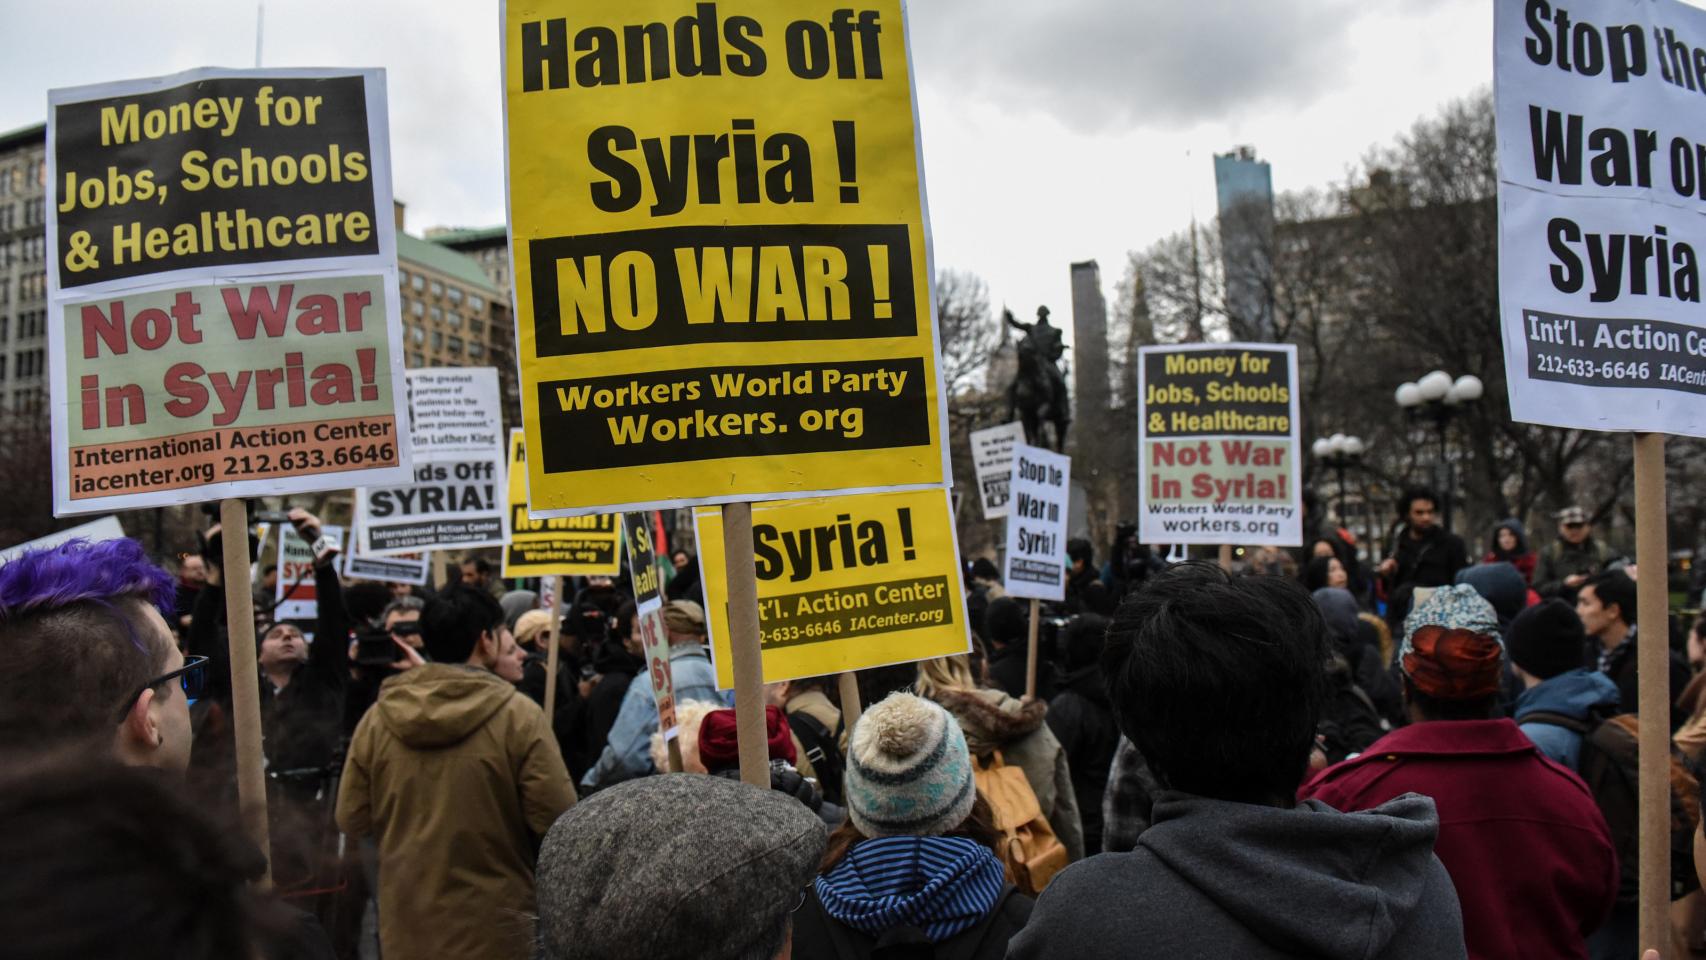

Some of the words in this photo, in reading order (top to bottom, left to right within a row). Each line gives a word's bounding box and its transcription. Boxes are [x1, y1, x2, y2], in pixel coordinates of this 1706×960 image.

[521, 2, 768, 93] Hands
[785, 9, 884, 80] off
[1524, 0, 1648, 83] Stop
[101, 94, 243, 146] Money
[256, 86, 322, 126] for
[1529, 104, 1658, 188] War
[59, 167, 168, 212] Jobs,
[181, 144, 368, 192] Schools
[587, 119, 814, 218] Syria
[65, 230, 99, 272] &
[113, 209, 371, 265] Healthcare
[1547, 217, 1700, 303] Syria
[556, 250, 660, 337] NO
[673, 244, 851, 325] WAR
[81, 291, 202, 359] Not
[220, 284, 372, 340] War
[1594, 323, 1680, 353] Action
[1165, 353, 1236, 377] Money
[1240, 351, 1271, 373] for
[1537, 354, 1650, 379] 212-633-6646
[81, 374, 147, 431] in
[163, 348, 379, 426] Syria!
[556, 375, 701, 412] Workers
[710, 370, 813, 399] World
[822, 367, 908, 398] Party
[1146, 382, 1200, 406] Jobs,
[1206, 381, 1289, 403] Schools
[1148, 412, 1165, 432] &
[1171, 410, 1289, 432] Healthcare
[74, 433, 222, 468] International
[230, 426, 307, 449] Action
[314, 421, 392, 445] Center
[431, 434, 467, 444] Luther
[471, 434, 495, 445] King
[1152, 441, 1212, 466] Not
[1221, 440, 1285, 466] War
[74, 463, 216, 494] iacenter.org
[223, 443, 394, 476] 212.633.6646
[454, 462, 495, 480] Off
[1019, 456, 1045, 485] Stop
[370, 485, 495, 517] SYRIA!
[1151, 474, 1181, 499] in
[1191, 472, 1286, 503] Syria!
[1017, 492, 1045, 519] War
[1148, 504, 1207, 514] Workers
[1212, 504, 1253, 514] World
[1257, 505, 1294, 519] Party
[372, 525, 435, 539] International
[437, 523, 465, 533] Action
[468, 522, 499, 532] Center
[1163, 517, 1279, 536] workers.org
[513, 542, 551, 552] Workers
[552, 541, 582, 550] World
[584, 540, 611, 551] Party
[752, 515, 888, 582] Syria
[796, 591, 869, 616] Action
[879, 581, 944, 606] Center
[850, 608, 944, 631] IACenter.org
